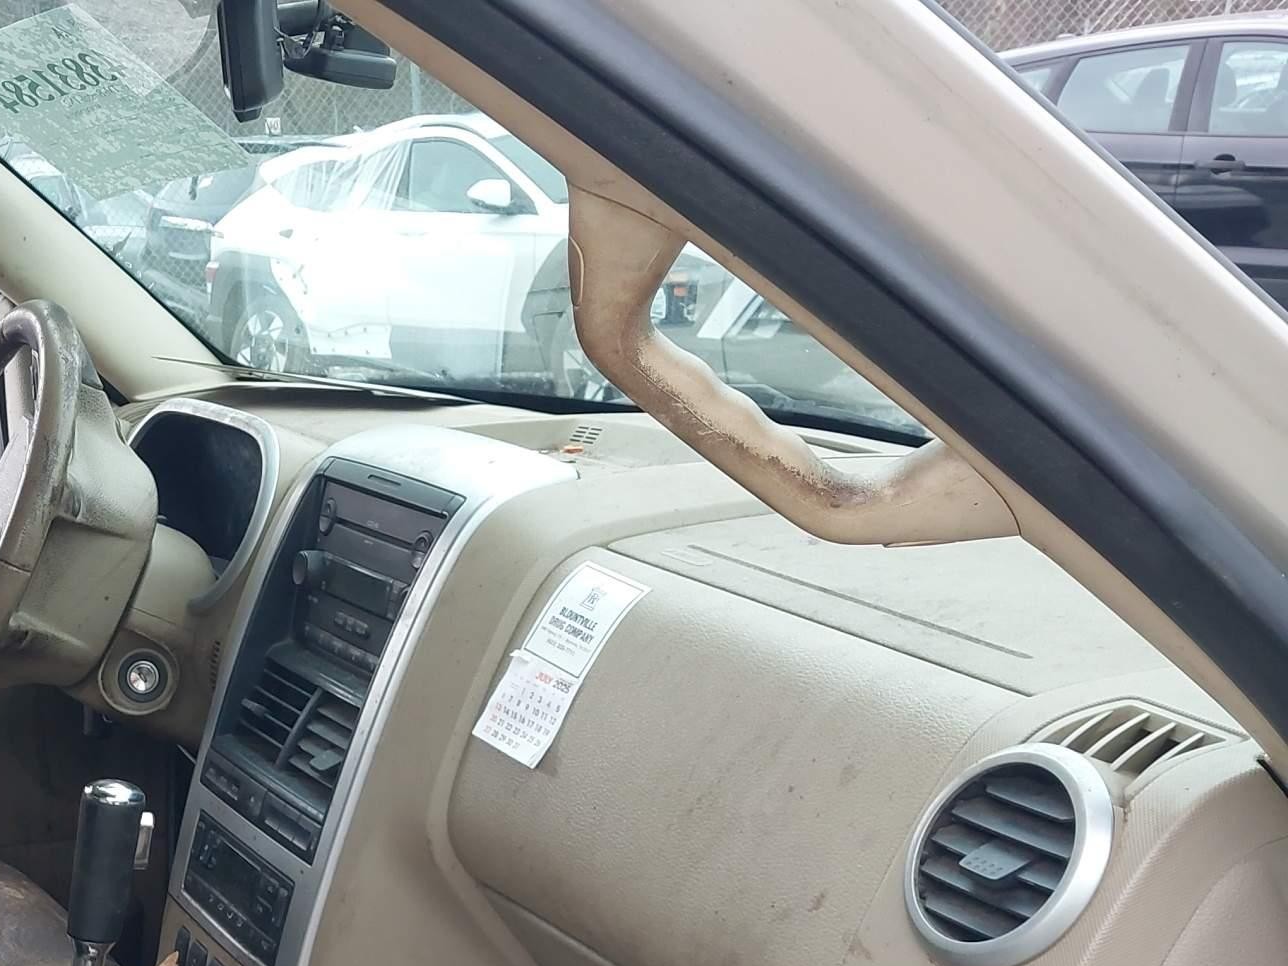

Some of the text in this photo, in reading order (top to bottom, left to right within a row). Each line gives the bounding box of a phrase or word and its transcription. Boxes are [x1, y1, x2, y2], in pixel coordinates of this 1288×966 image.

[548, 615, 565, 632] DRUG
[564, 623, 595, 645] COMPANY
[559, 606, 598, 632] BLOUNTVILLE
[536, 672, 571, 694] JULY 2025
[496, 703, 502, 711] 13
[503, 706, 509, 715] 14
[511, 711, 517, 720] 15
[519, 715, 525, 724] 16
[527, 719, 535, 728] 17
[535, 724, 542, 733] 18
[532, 707, 540, 716] 10
[541, 711, 548, 720] 11
[491, 730, 499, 738] 28
[497, 718, 504, 726] 21
[505, 723, 512, 731] 22
[513, 727, 520, 735] 23
